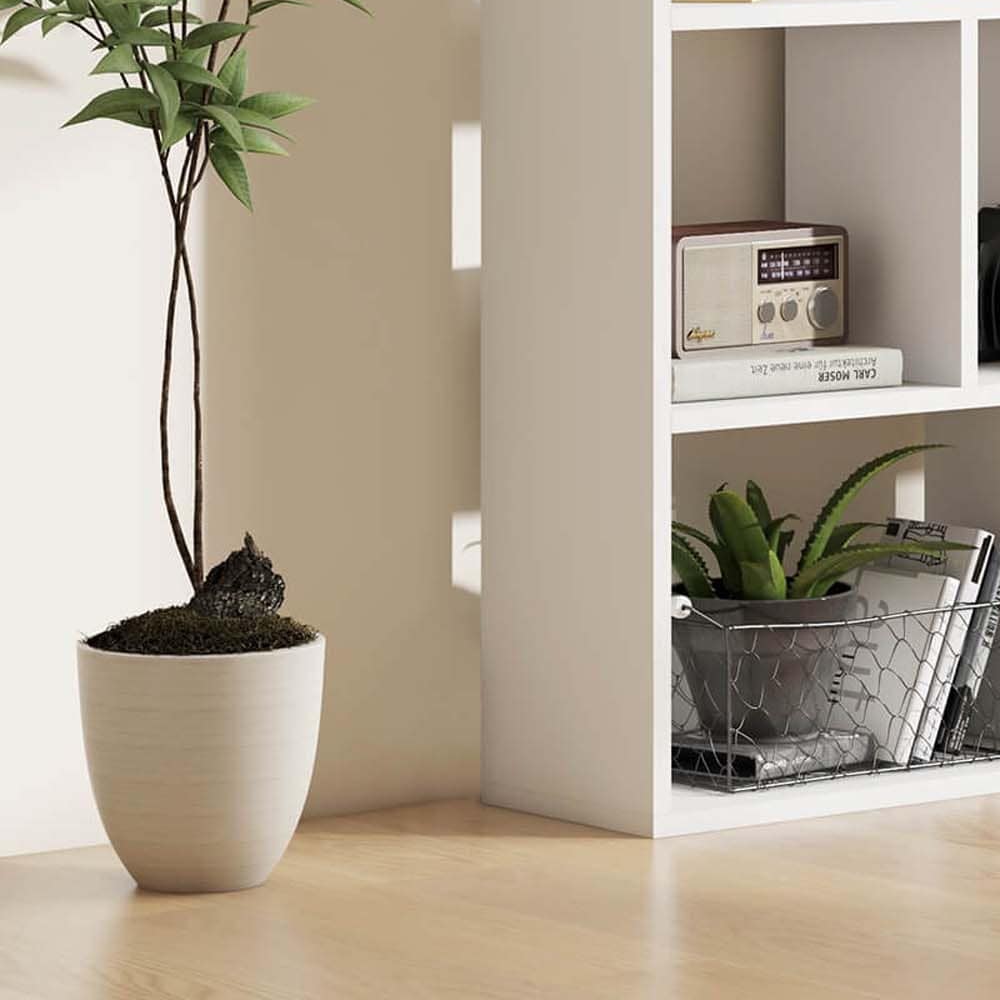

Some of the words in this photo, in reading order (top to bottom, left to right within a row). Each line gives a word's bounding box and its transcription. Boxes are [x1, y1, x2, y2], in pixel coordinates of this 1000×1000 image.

[751, 365, 769, 376] Zeit
[818, 370, 850, 383] MOSER
[853, 368, 877, 380] CARL
